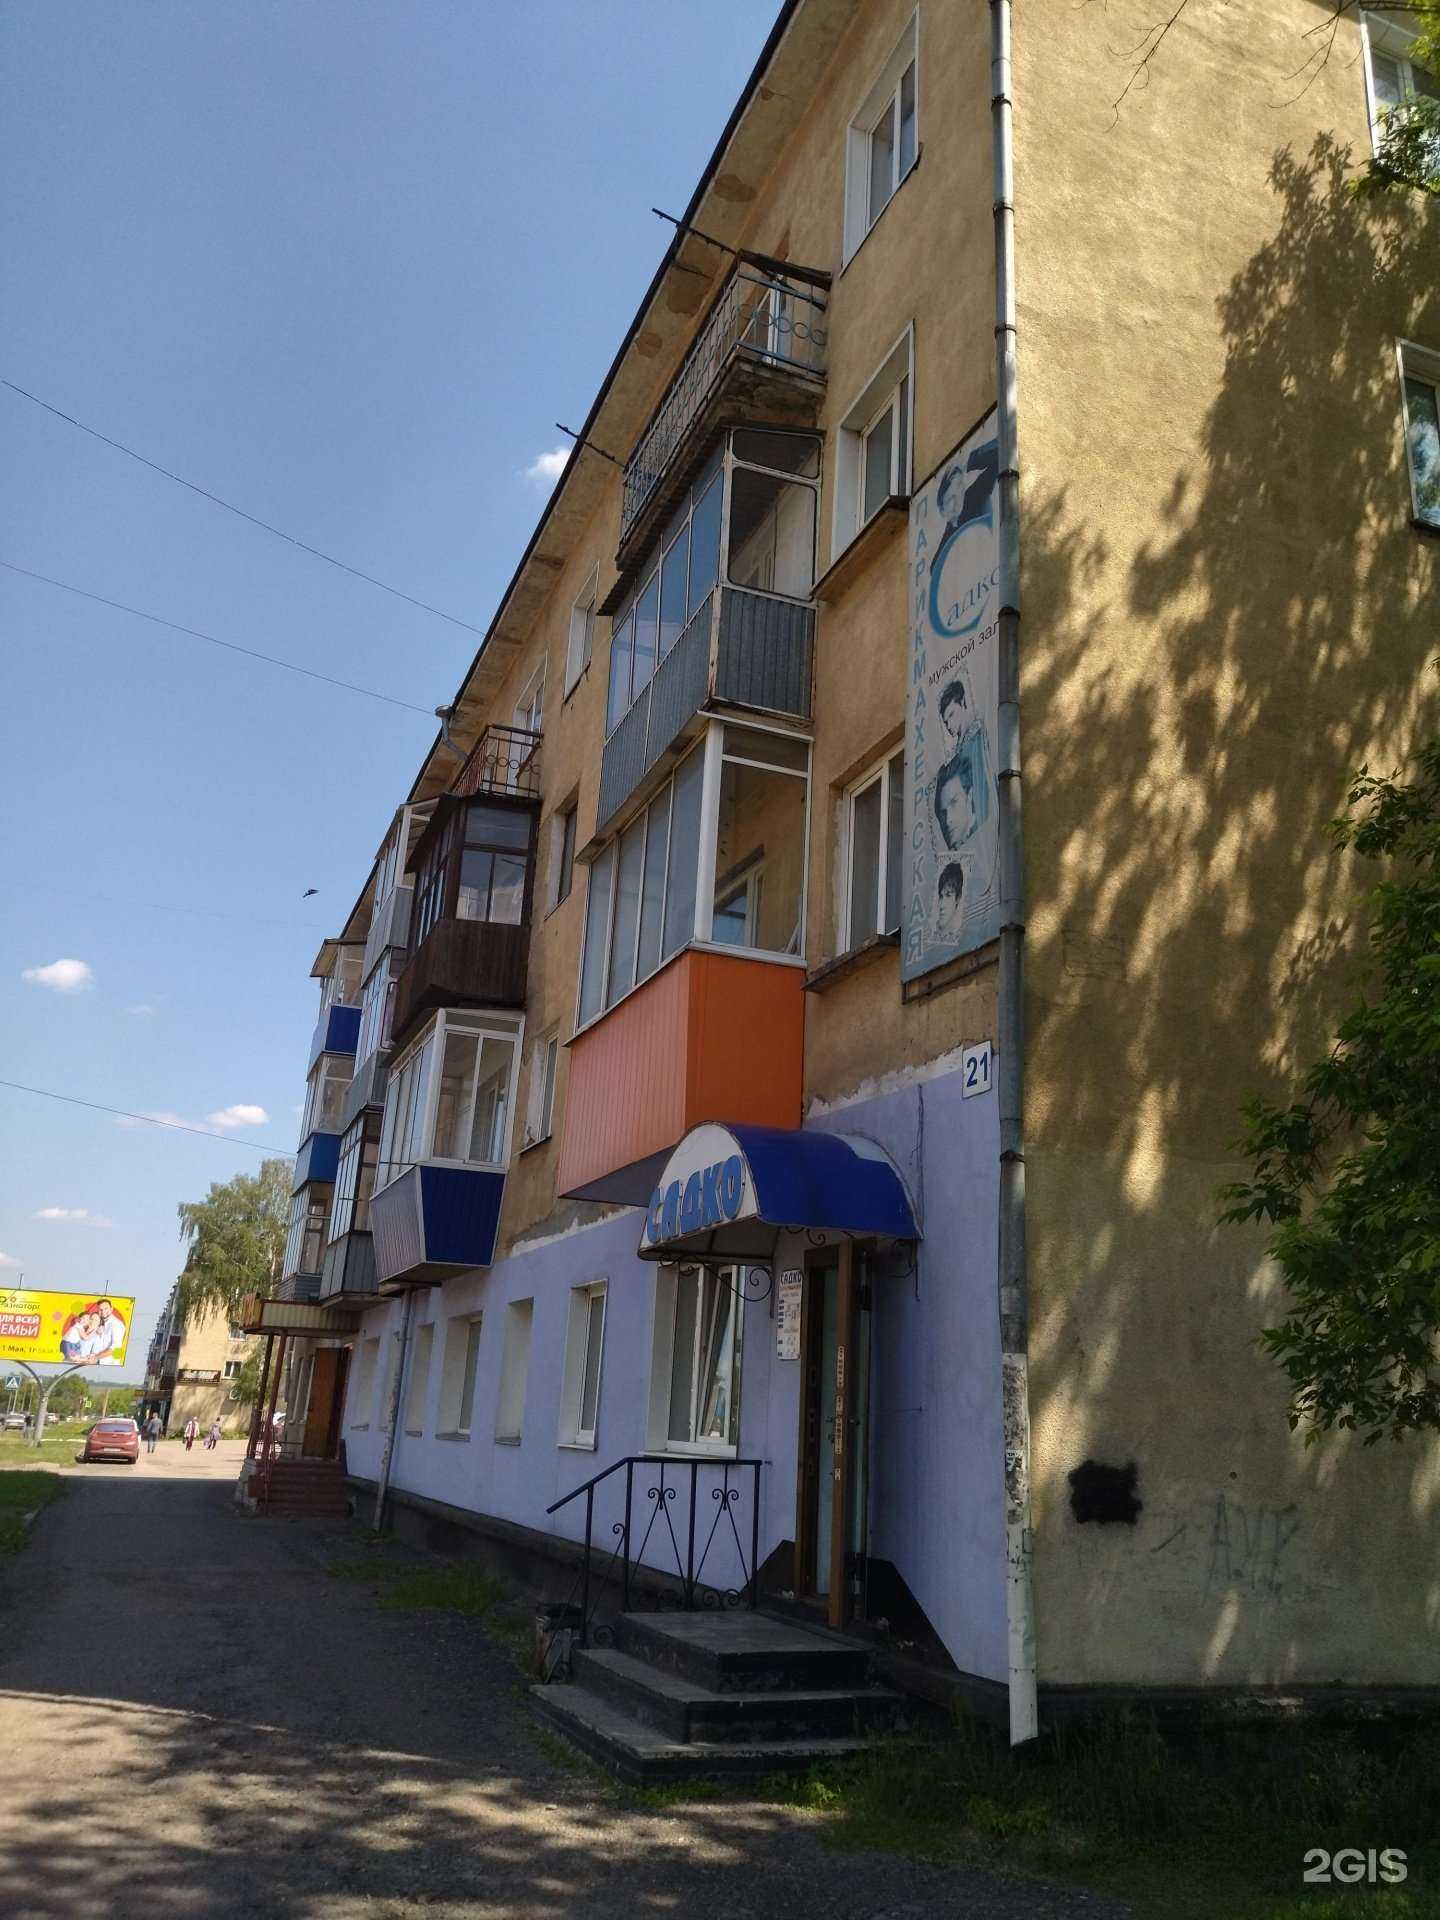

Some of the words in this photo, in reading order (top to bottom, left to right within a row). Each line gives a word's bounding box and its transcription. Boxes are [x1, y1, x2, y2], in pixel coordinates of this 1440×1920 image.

[905, 494, 928, 966] ПАРИКМАХЕРСКАЯ
[966, 1051, 988, 1088] 21
[0, 1323, 38, 1337] ЕМЬИ
